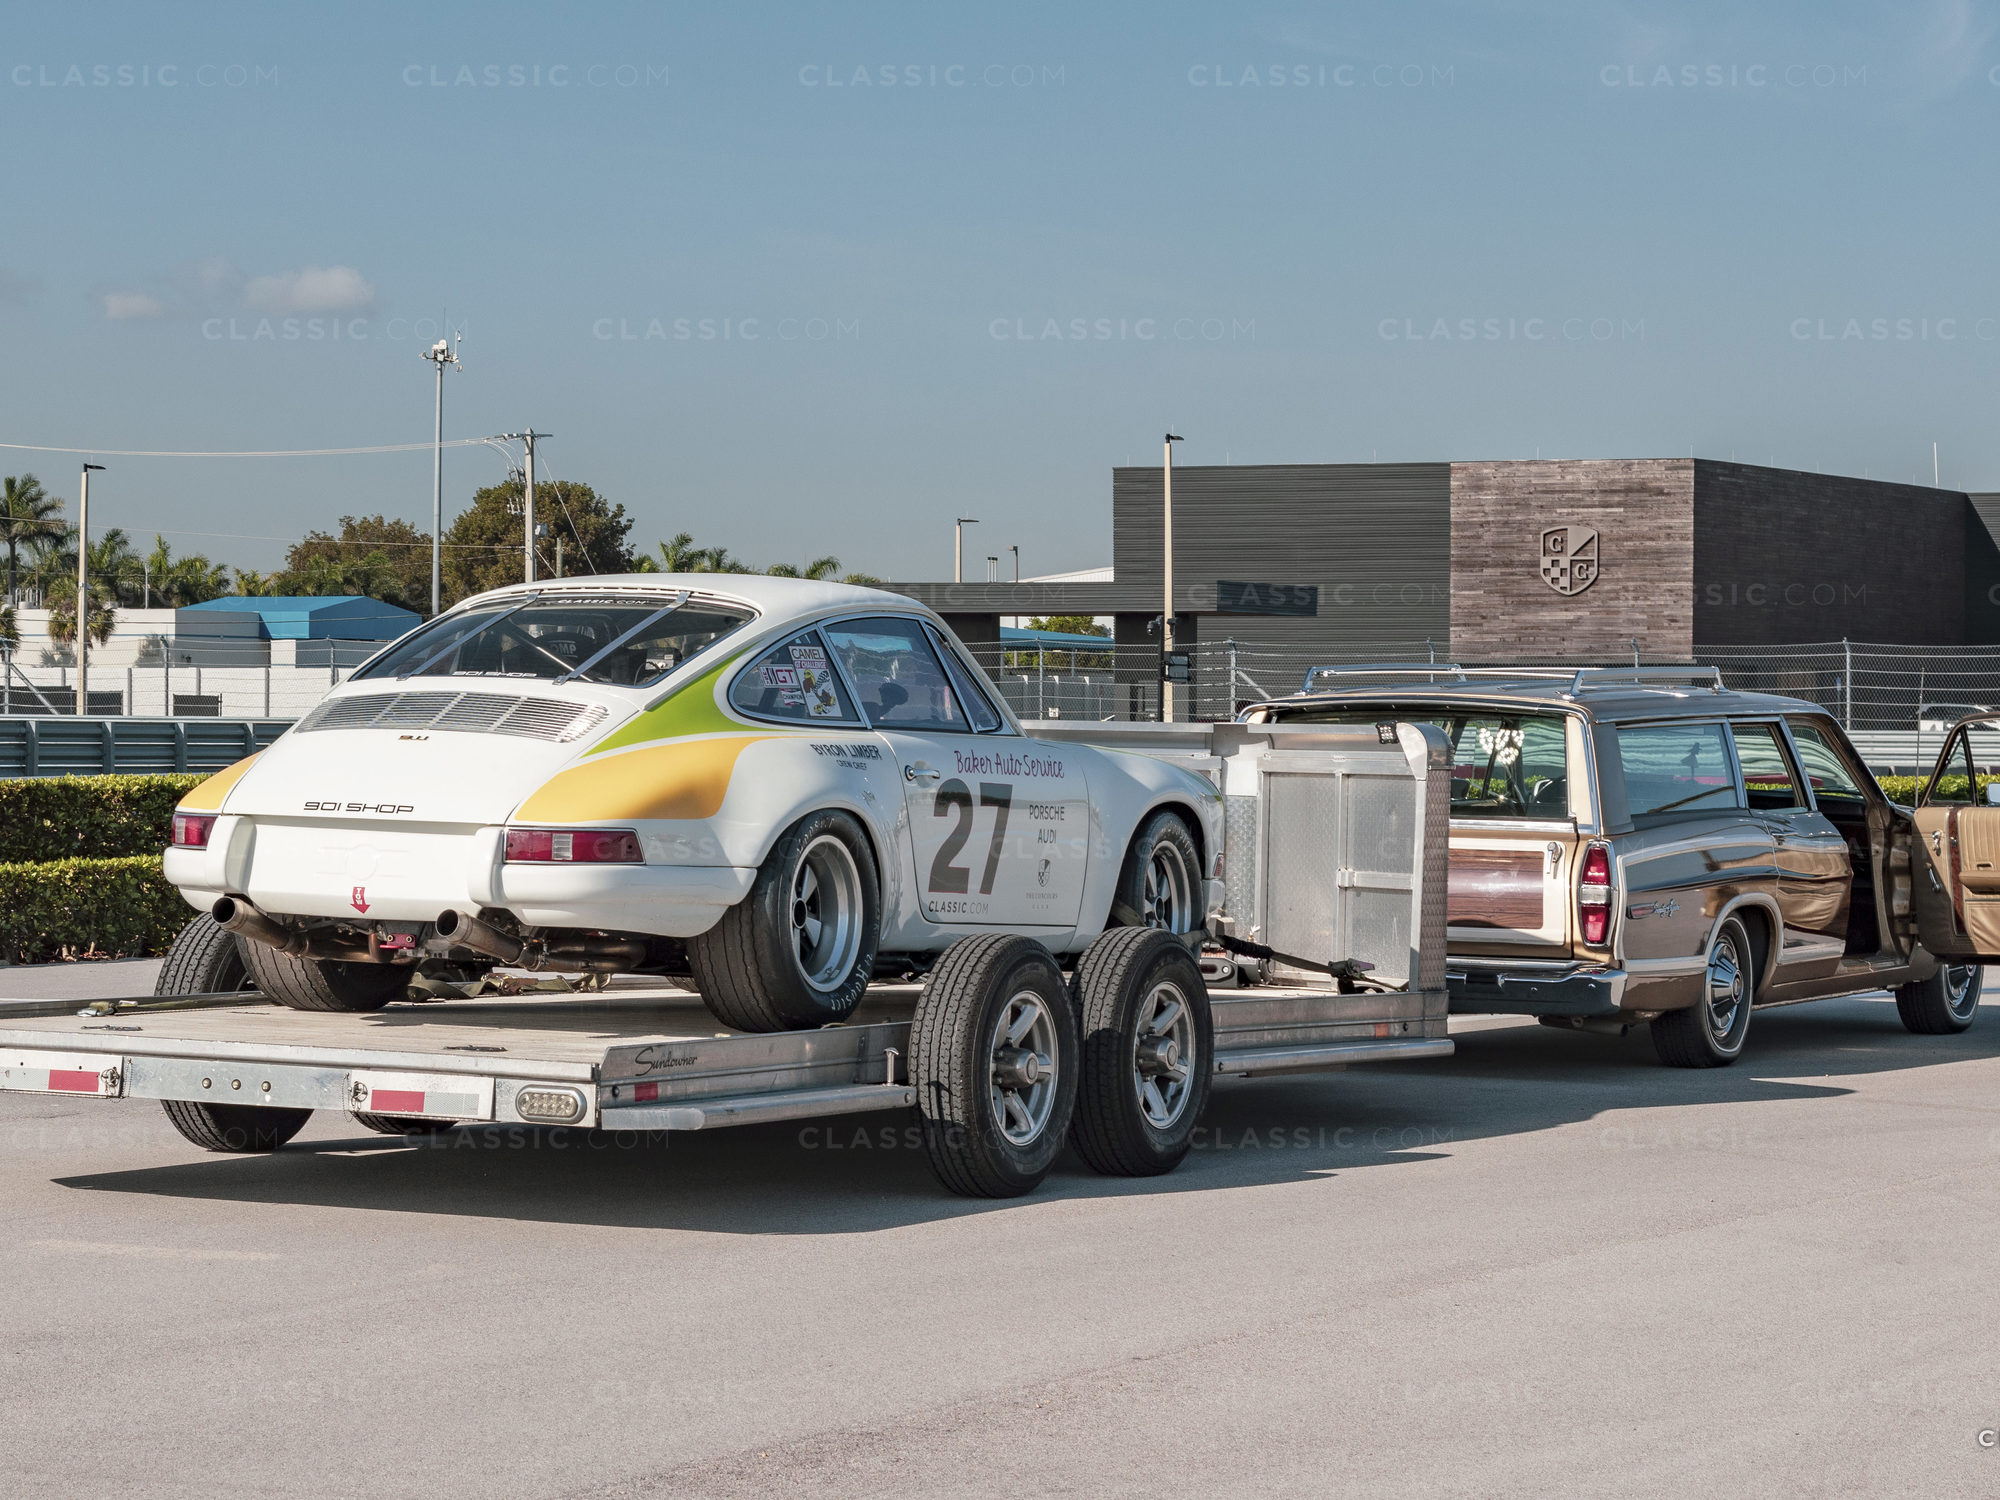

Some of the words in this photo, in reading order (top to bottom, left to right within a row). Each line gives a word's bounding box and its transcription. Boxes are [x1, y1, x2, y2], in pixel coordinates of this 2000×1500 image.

[791, 648, 825, 660] CAMEL
[775, 669, 794, 684] GT
[810, 744, 847, 757] BYRON
[845, 744, 883, 760] LIMBER
[954, 749, 993, 775] Baker
[995, 752, 1023, 776] Auto
[1022, 754, 1065, 778] Service
[345, 803, 415, 814] SHOP
[1029, 804, 1065, 821] PORSCHE
[928, 778, 1013, 895] 27
[1038, 828, 1057, 844] AUDI
[928, 901, 989, 914] CLASSIC.COM
[634, 1046, 698, 1077] Sundowner
